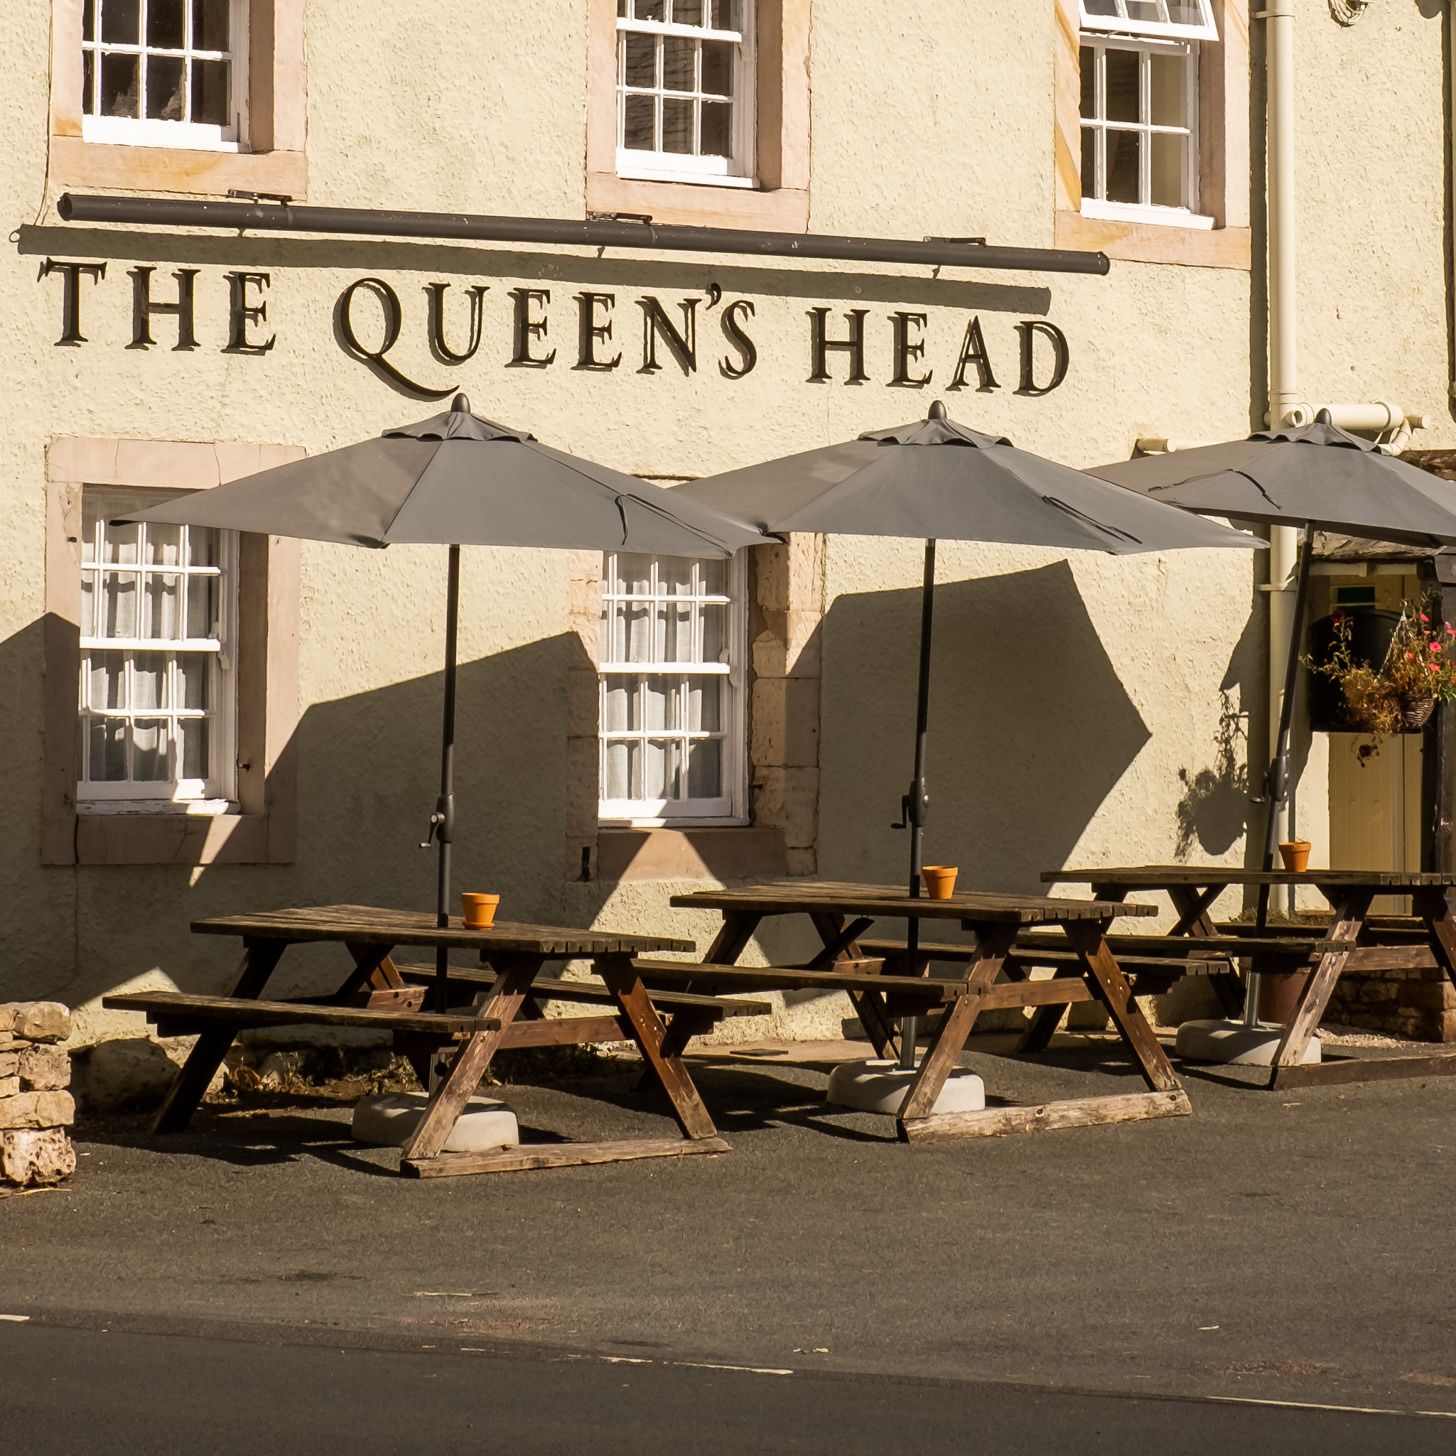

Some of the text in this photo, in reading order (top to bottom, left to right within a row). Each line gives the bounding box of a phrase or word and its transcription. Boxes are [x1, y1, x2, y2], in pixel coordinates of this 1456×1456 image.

[42, 257, 1070, 401] THE QUEEN'S HEAD
